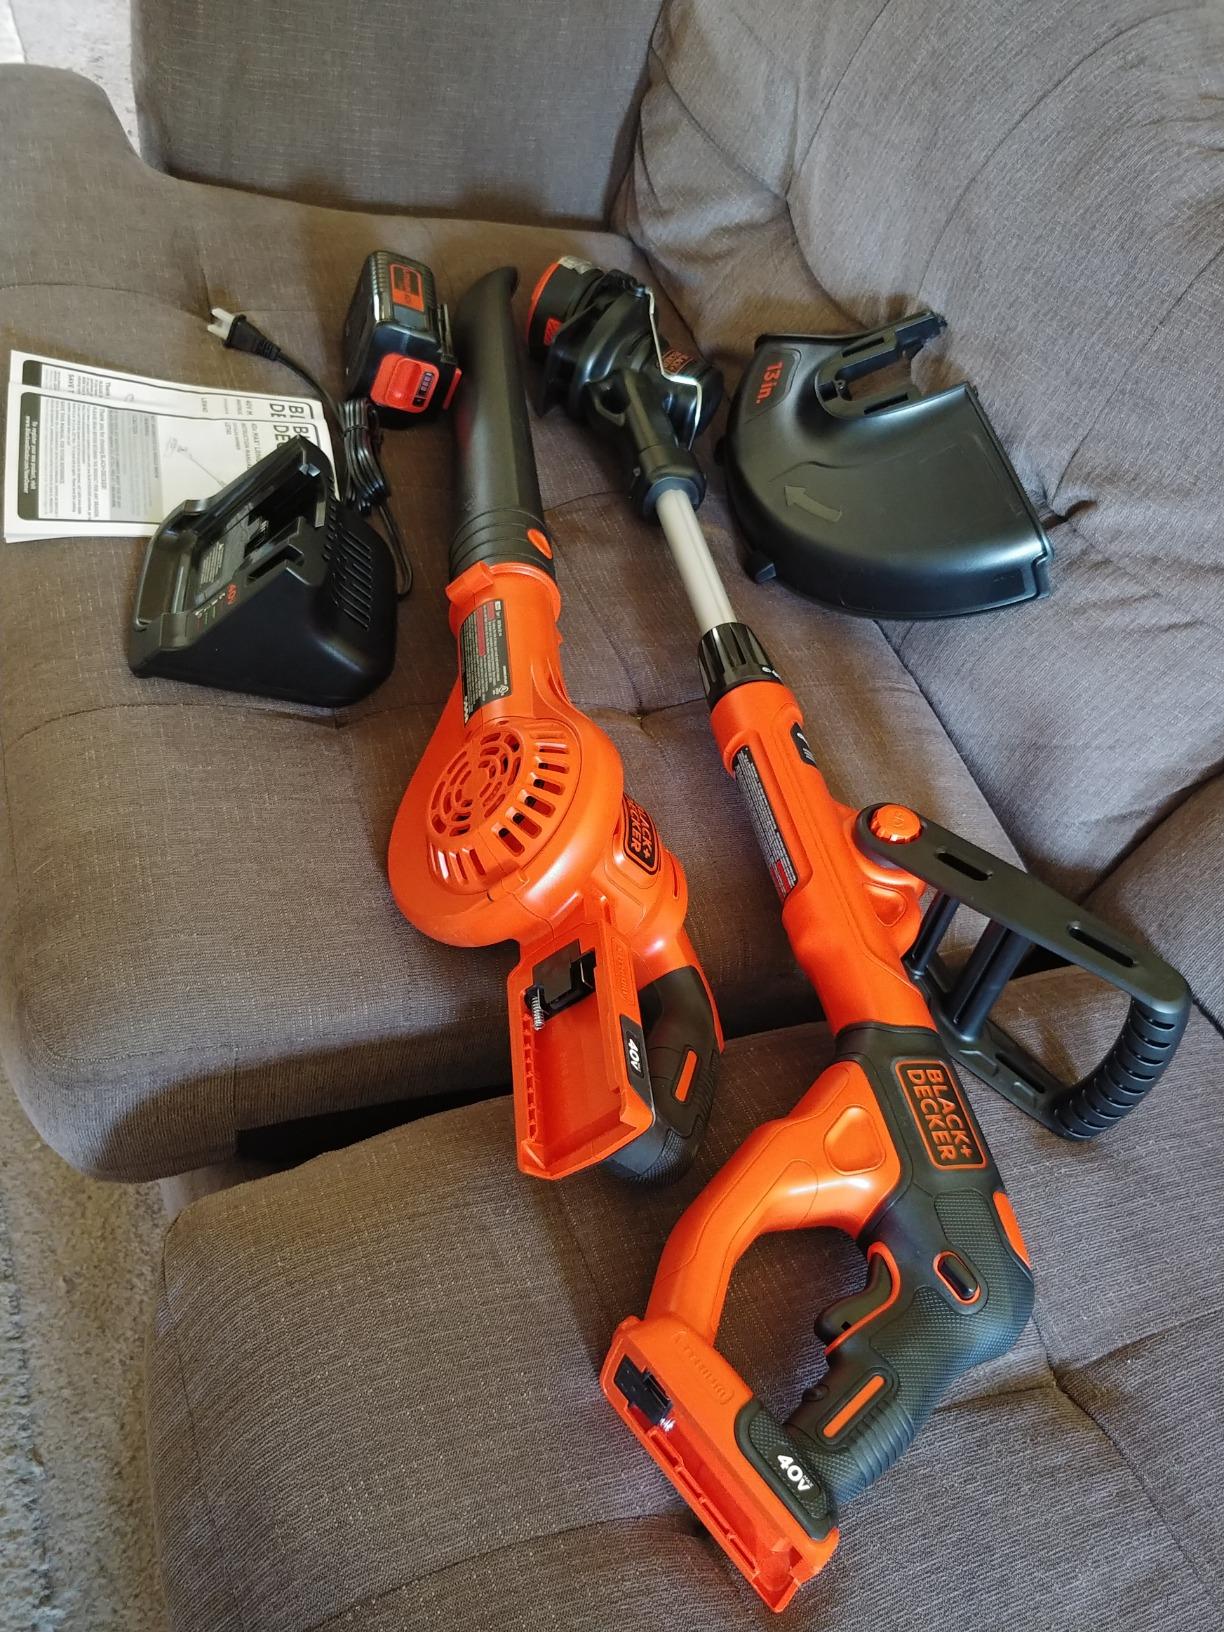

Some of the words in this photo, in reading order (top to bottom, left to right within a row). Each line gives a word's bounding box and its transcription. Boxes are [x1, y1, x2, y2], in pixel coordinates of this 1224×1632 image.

[628, 1038, 641, 1073] 40V
[906, 1069, 957, 1160] DECKER
[777, 1454, 811, 1491] 40V
